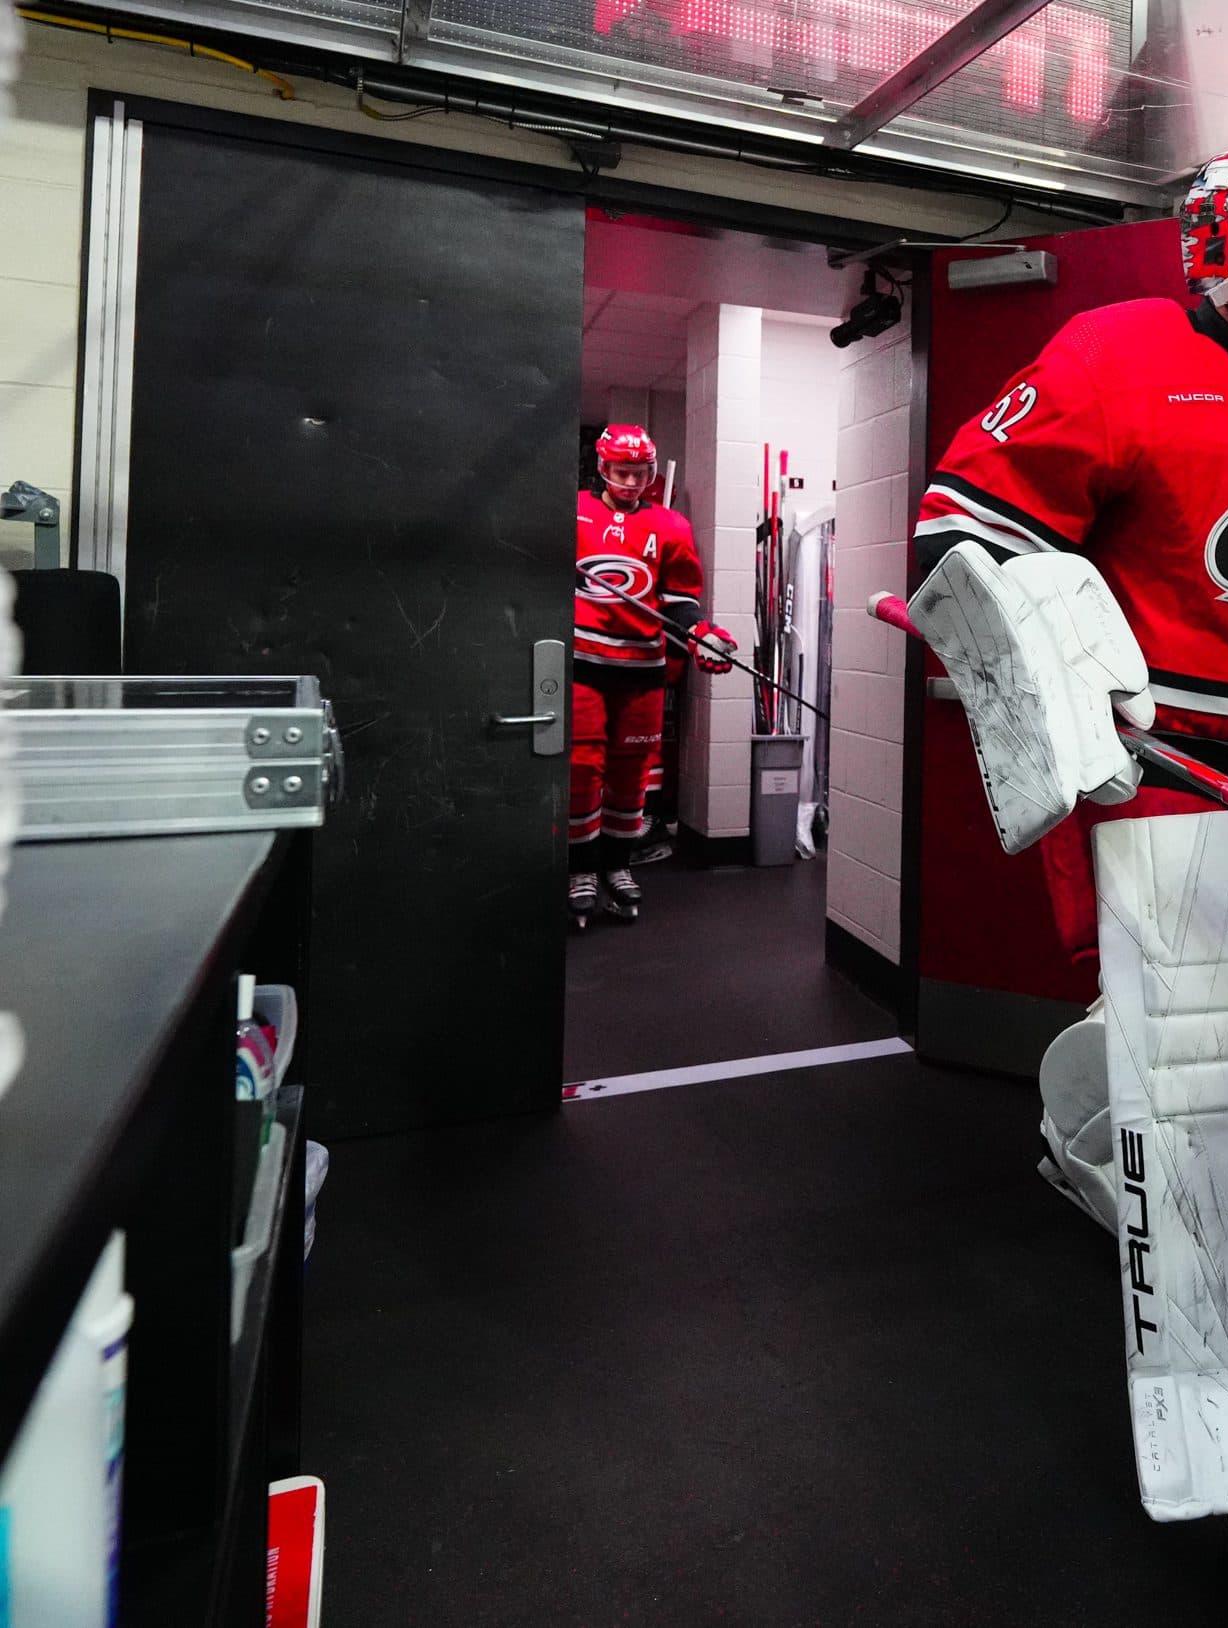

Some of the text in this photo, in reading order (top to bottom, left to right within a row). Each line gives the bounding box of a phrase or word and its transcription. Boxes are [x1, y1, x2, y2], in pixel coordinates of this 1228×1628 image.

[981, 382, 1037, 443] 52
[1168, 393, 1225, 402] NUCOR
[642, 533, 657, 559] A
[783, 583, 795, 635] CCM
[1120, 1128, 1158, 1355] TRUE
